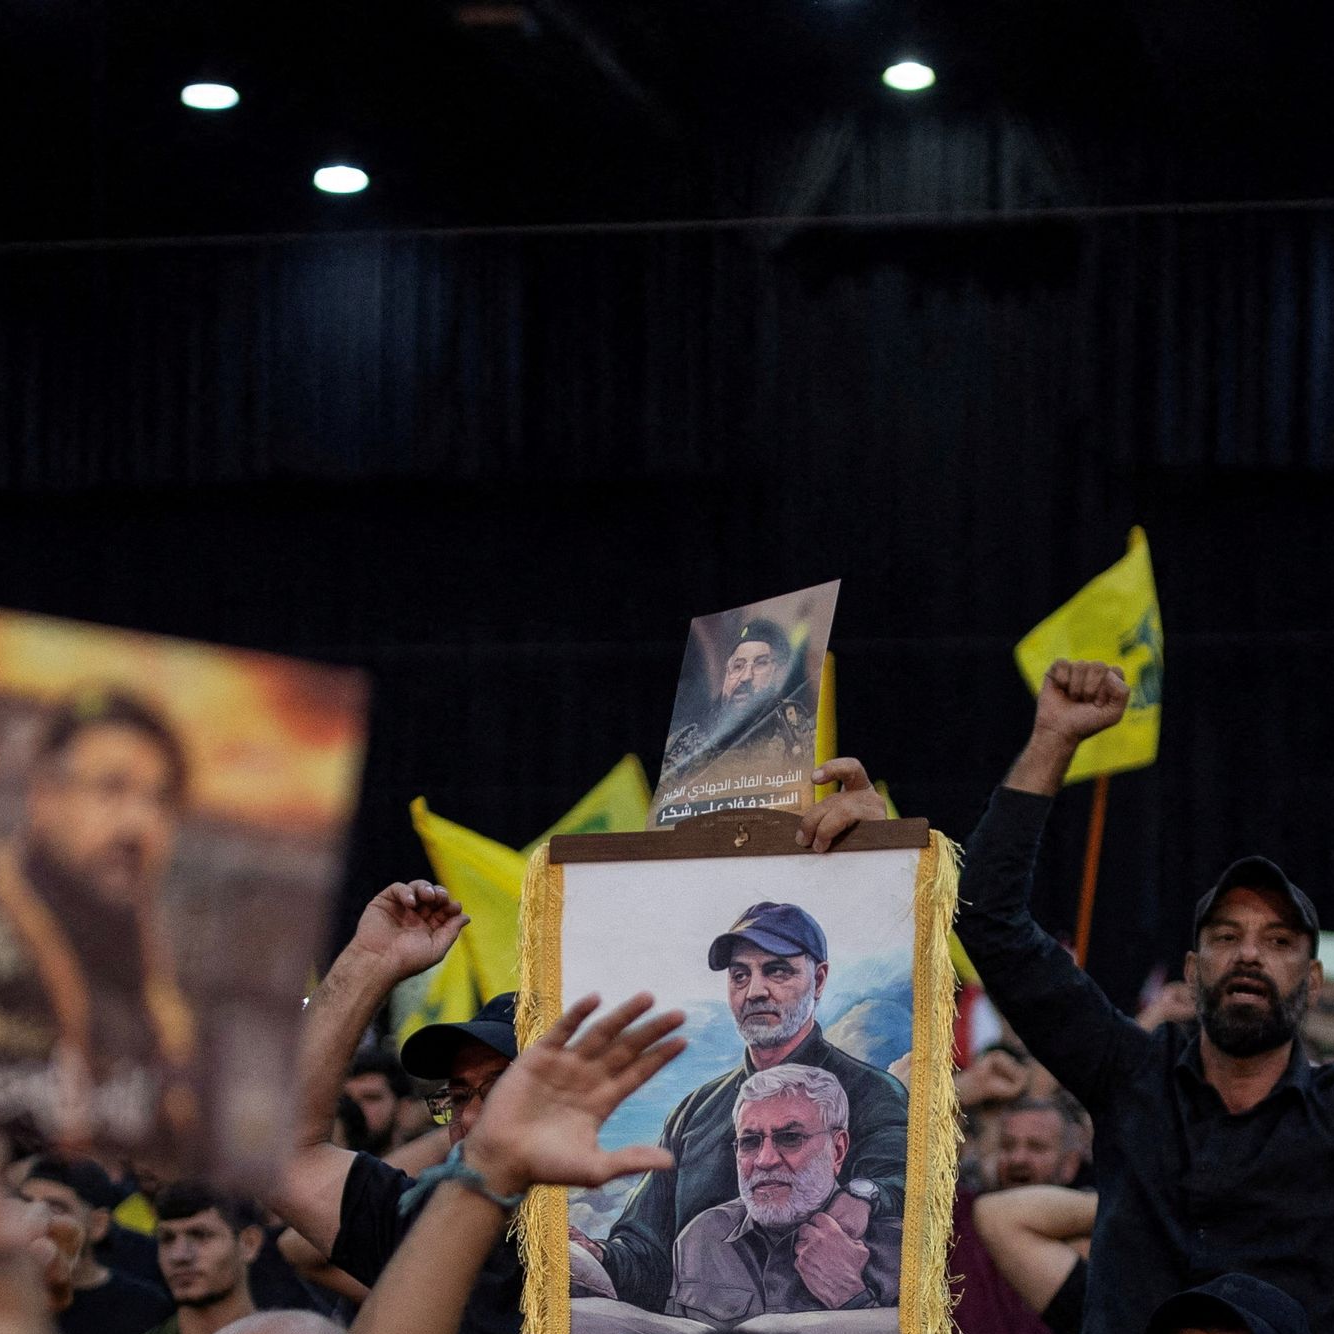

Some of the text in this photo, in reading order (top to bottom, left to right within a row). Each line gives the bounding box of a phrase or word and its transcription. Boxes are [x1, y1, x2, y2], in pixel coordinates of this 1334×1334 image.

[734, 774, 763, 790] القائد
[765, 769, 802, 787] الشهيد
[687, 779, 731, 800] الجهادي
[660, 803, 692, 823] شكر
